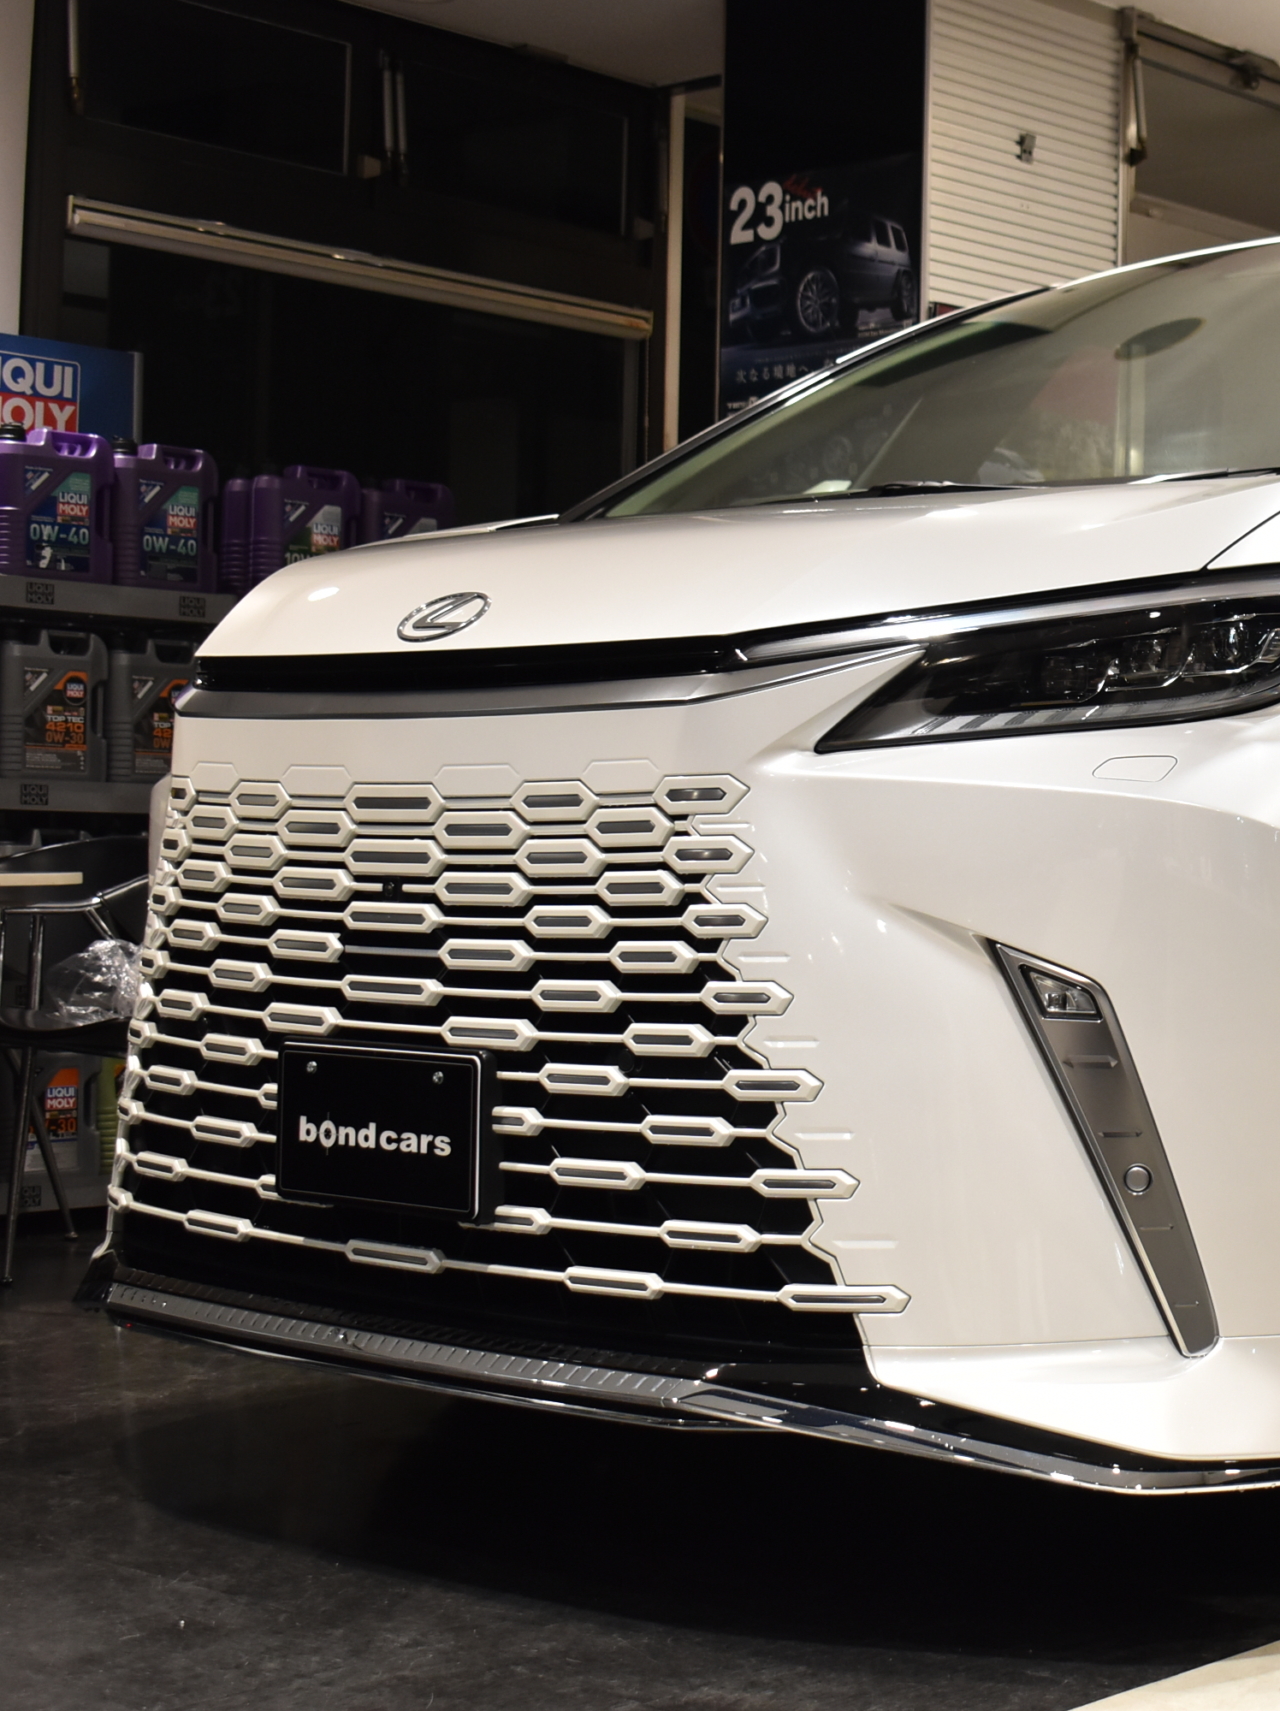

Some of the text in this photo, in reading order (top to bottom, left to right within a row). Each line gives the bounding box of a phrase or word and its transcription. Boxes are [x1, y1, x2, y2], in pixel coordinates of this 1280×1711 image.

[0, 356, 73, 398] QUI
[0, 396, 76, 432] OLY
[59, 492, 88, 504] LIQUI
[59, 504, 89, 516] MOLY
[169, 504, 196, 517] LIQUI
[169, 516, 197, 528] MOLY
[30, 523, 89, 545] 0W-40
[313, 523, 339, 535] LIQUI
[143, 535, 197, 556] 0W-40
[313, 534, 340, 546] MOLY
[28, 583, 53, 594] LIQUI
[28, 593, 53, 604] MOLY
[66, 683, 84, 691] LIQUI
[46, 722, 84, 732] 4210
[45, 732, 84, 743] 0W-30
[22, 784, 48, 794] LIQUI
[22, 794, 48, 805] MOLY
[47, 1087, 75, 1097] LIQUI
[47, 1098, 76, 1109] MOLY
